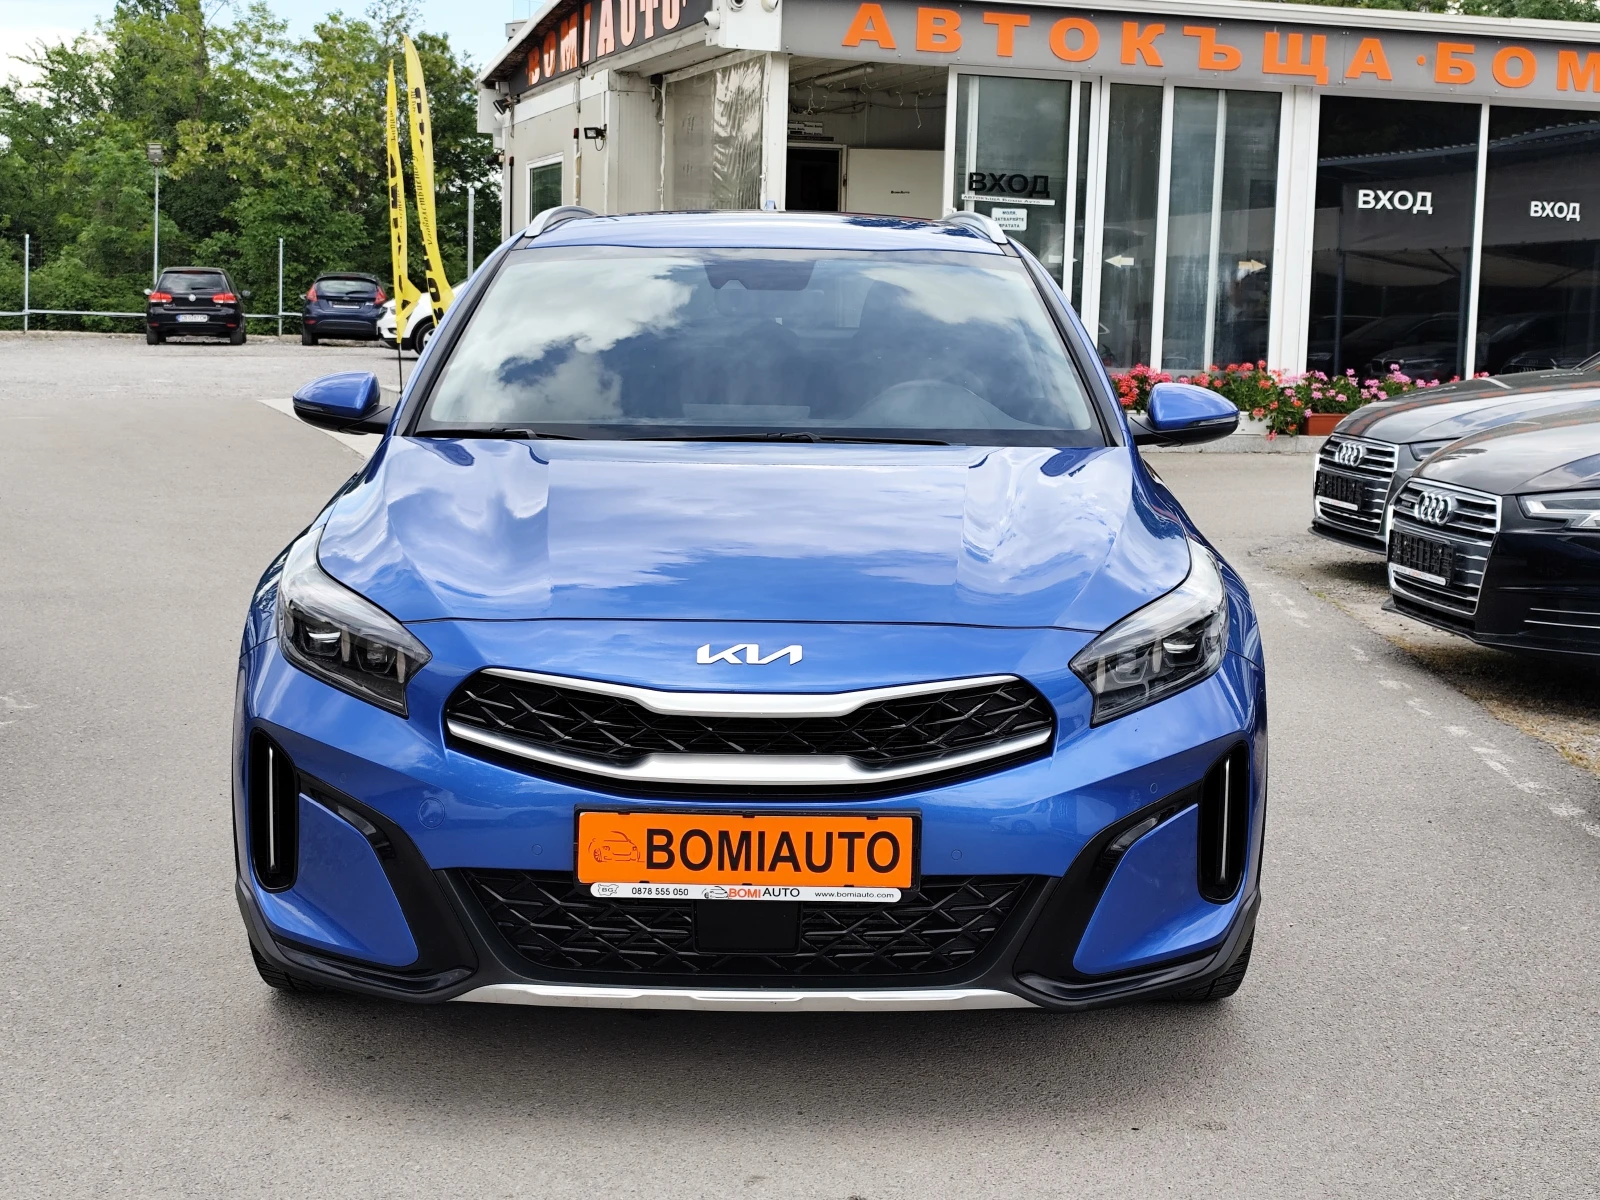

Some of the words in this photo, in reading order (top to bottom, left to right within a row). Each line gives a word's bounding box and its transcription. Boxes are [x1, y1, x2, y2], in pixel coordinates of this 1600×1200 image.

[841, 3, 1393, 85] АВТОКЪЩА
[968, 172, 1051, 198] ВХОД
[1357, 189, 1433, 214] ВХОД
[1529, 201, 1581, 221] ВХОД
[696, 643, 803, 666] KIA
[646, 828, 901, 874] BOMIAUTO
[631, 886, 653, 896] 0878
[655, 887, 672, 896] 555
[672, 887, 689, 896] 050
[814, 891, 895, 899] www.bomiauto.com
